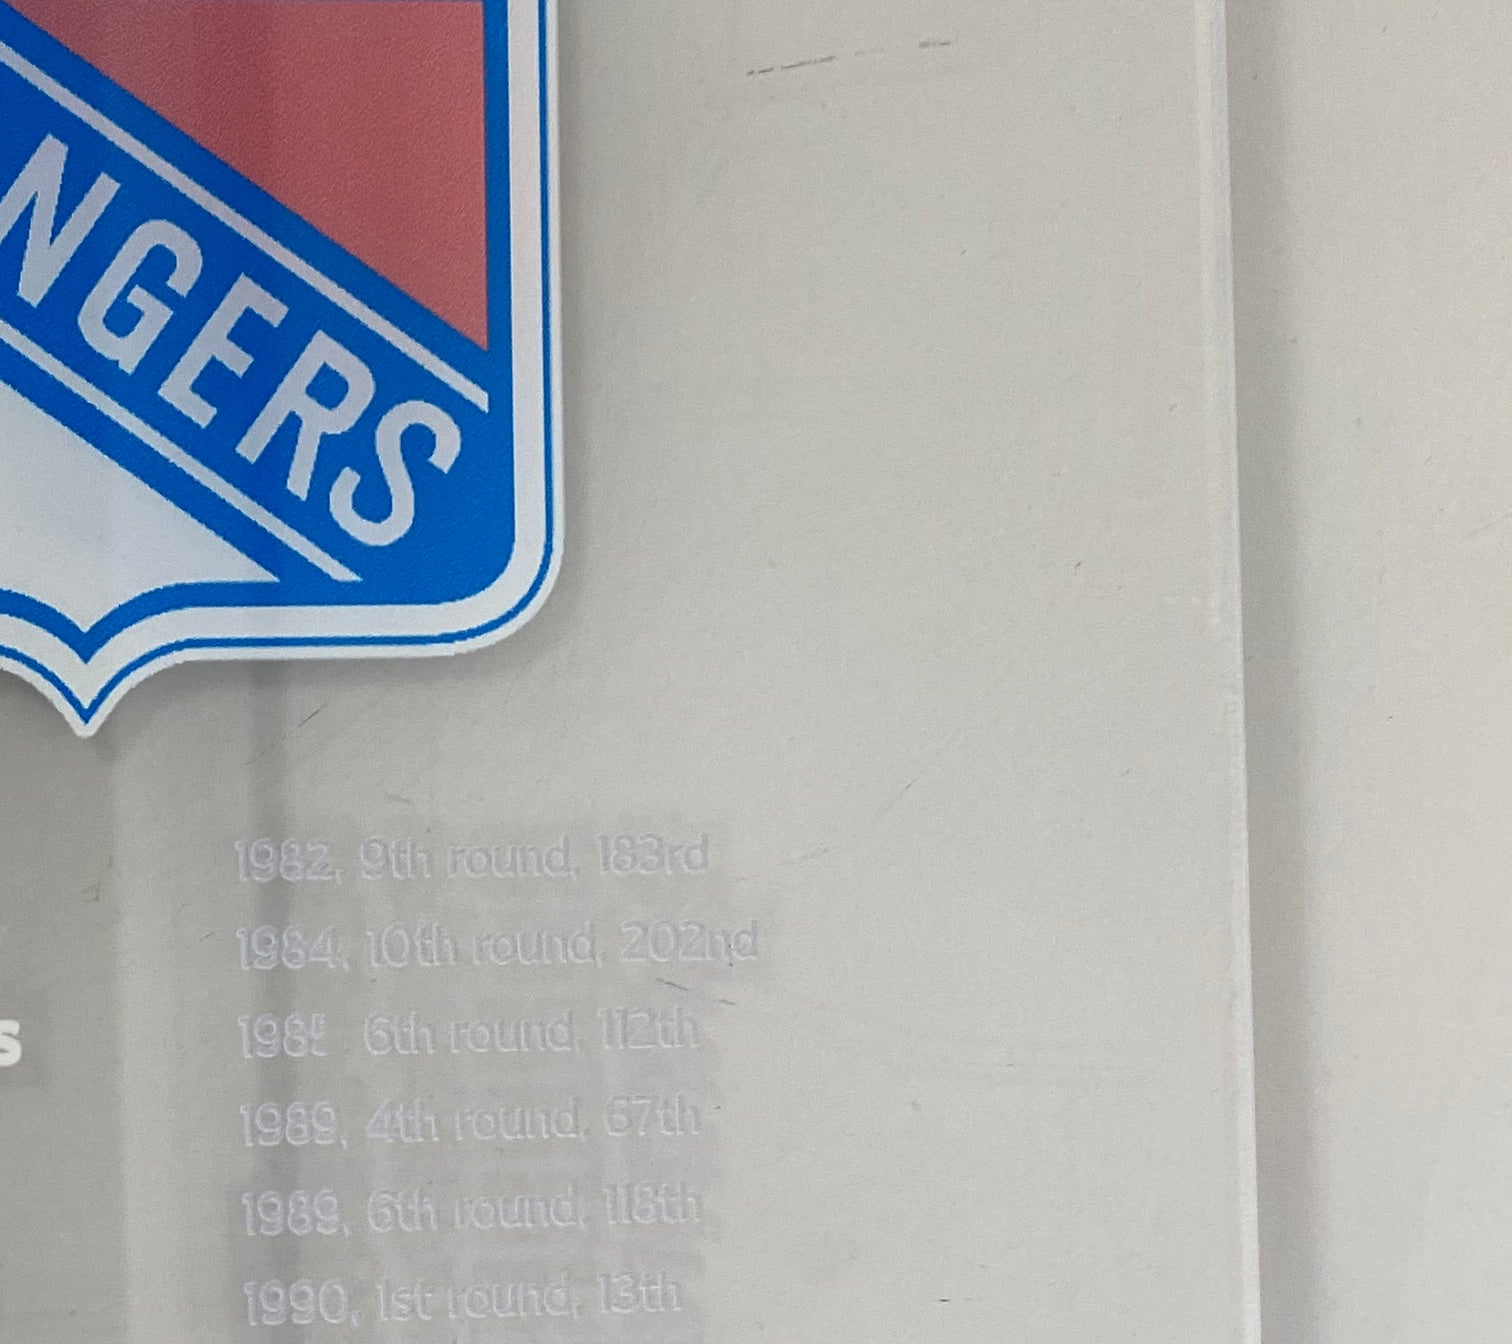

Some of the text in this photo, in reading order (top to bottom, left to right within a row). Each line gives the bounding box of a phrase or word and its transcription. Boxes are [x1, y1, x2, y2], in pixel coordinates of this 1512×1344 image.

[366, 922, 456, 967] 10th
[620, 919, 759, 962] 202nd
[363, 1010, 435, 1056] 6th
[364, 1098, 440, 1144] 4th
[368, 1187, 439, 1233] 6th
[243, 1278, 360, 1327] 1990,
[377, 1279, 433, 1322] 1st
